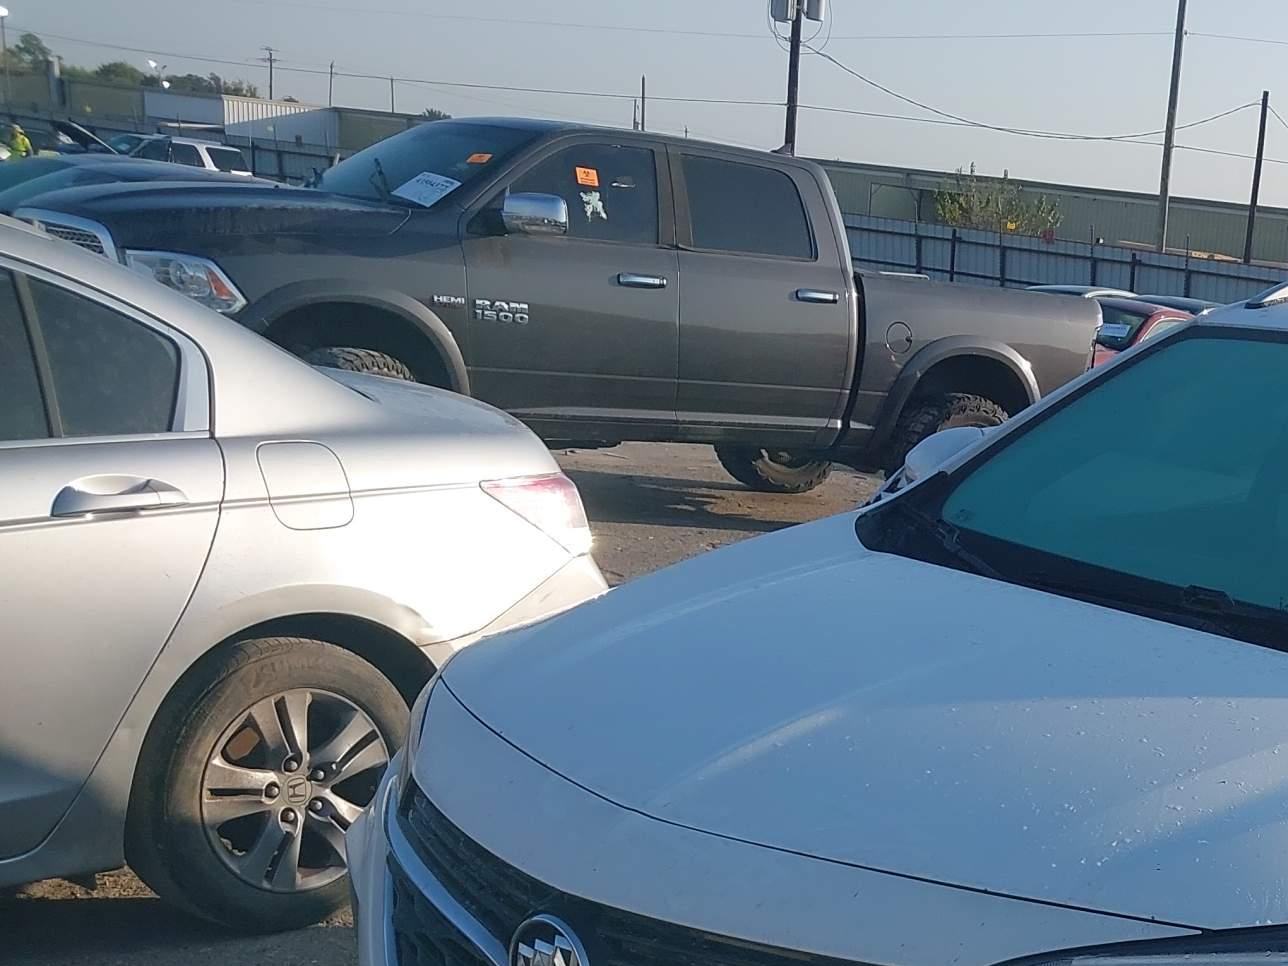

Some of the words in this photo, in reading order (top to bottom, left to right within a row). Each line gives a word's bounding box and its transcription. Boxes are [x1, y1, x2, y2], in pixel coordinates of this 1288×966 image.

[432, 294, 465, 304] HEMI
[475, 299, 529, 313] RAM
[475, 309, 529, 325] 1500
